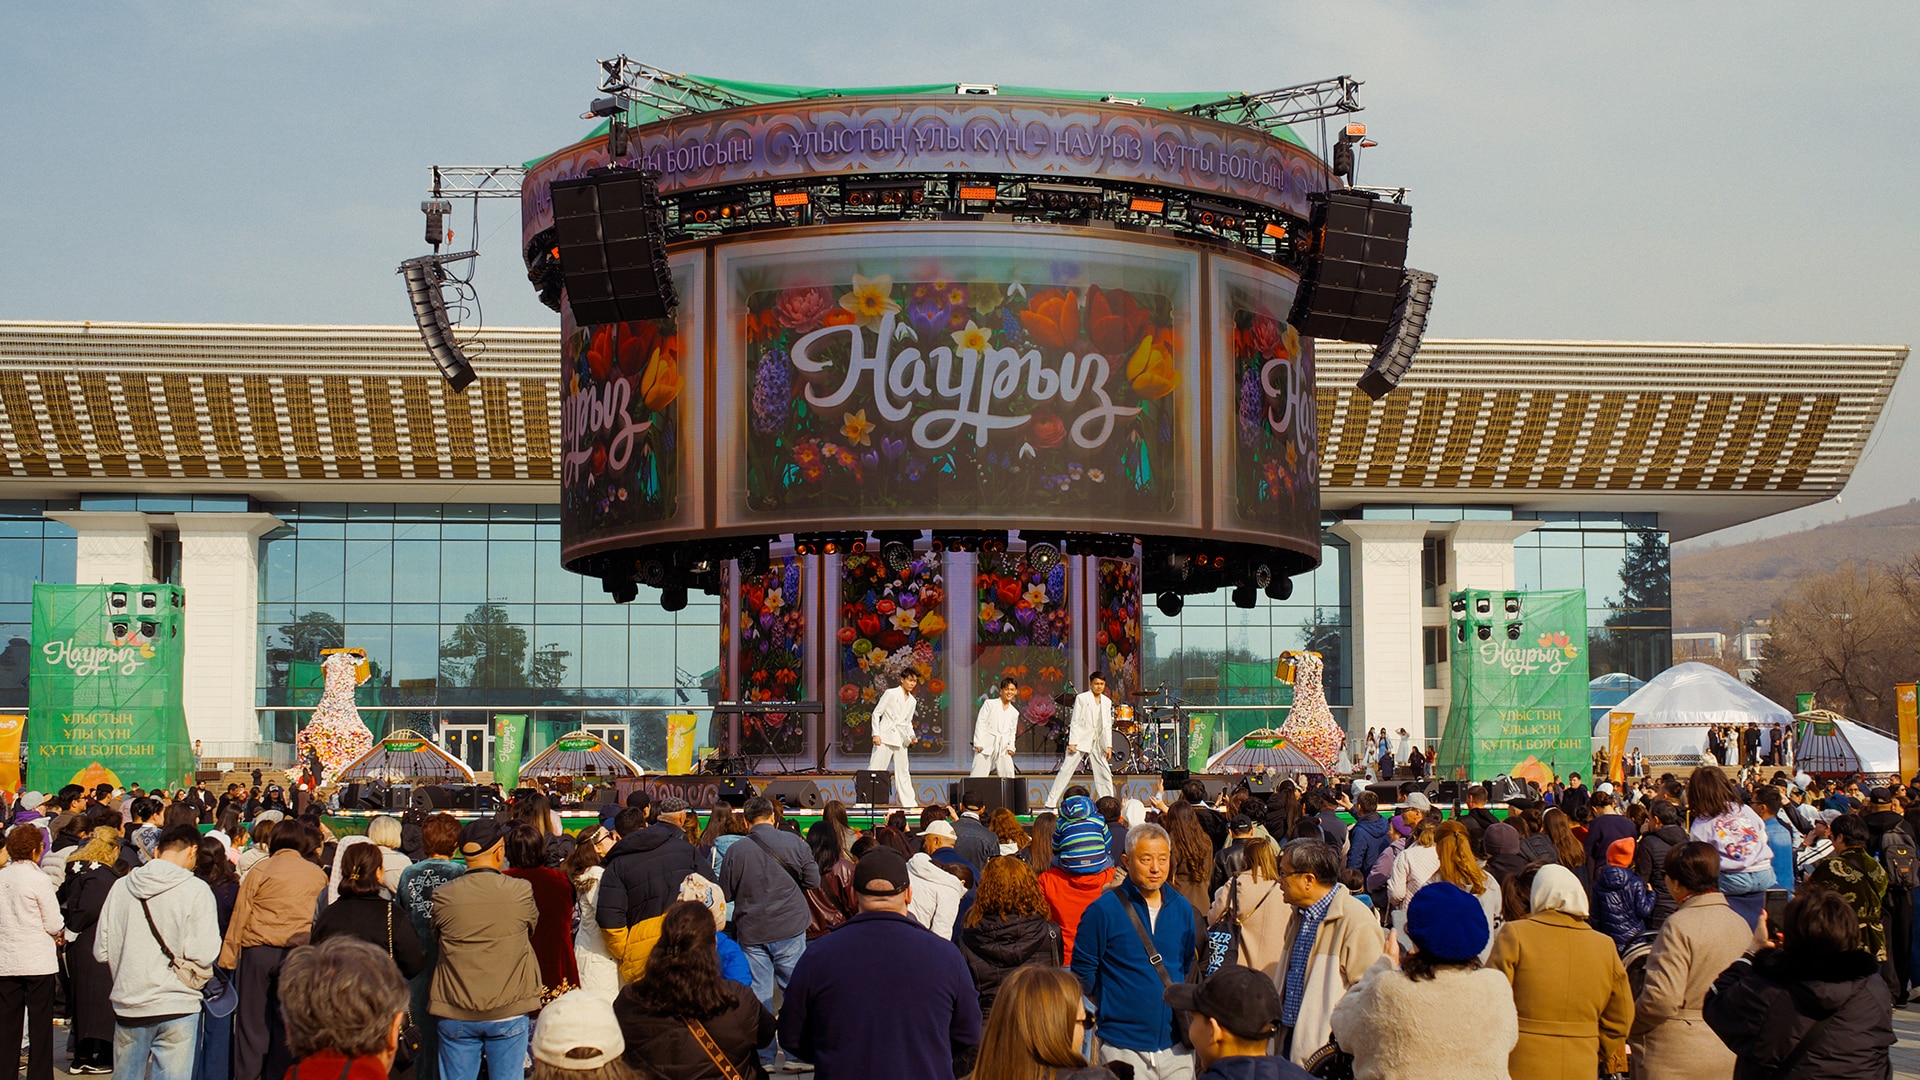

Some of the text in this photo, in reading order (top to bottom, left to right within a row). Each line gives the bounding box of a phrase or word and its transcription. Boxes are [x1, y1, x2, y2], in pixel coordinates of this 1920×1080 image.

[667, 138, 753, 174] БОЛСЫН!
[788, 126, 908, 156] ҰЛЫСТЫҢ
[916, 126, 965, 152] ҰЛЫ
[973, 127, 1027, 153] КҮНІ
[1055, 131, 1142, 163] НАУРЫЗ
[1152, 138, 1216, 173] ҚҰТТЫ
[1218, 153, 1285, 193] БОЛСЫН!
[791, 311, 1142, 449] Наурыз
[42, 638, 145, 676] Наурыз
[1480, 640, 1569, 675] Наурыз
[61, 713, 133, 725] ҰЛЫСТЫҢ
[1499, 710, 1562, 722] ҰЛЫСТЫҢ
[63, 728, 94, 739] ҰЛЫ
[1502, 724, 1529, 735] ҰЛЫ
[39, 744, 155, 757] ҚҰТТЫ БОЛСЫН!
[1481, 739, 1582, 752] ҚҰТТЫ БОЛСЫН!
